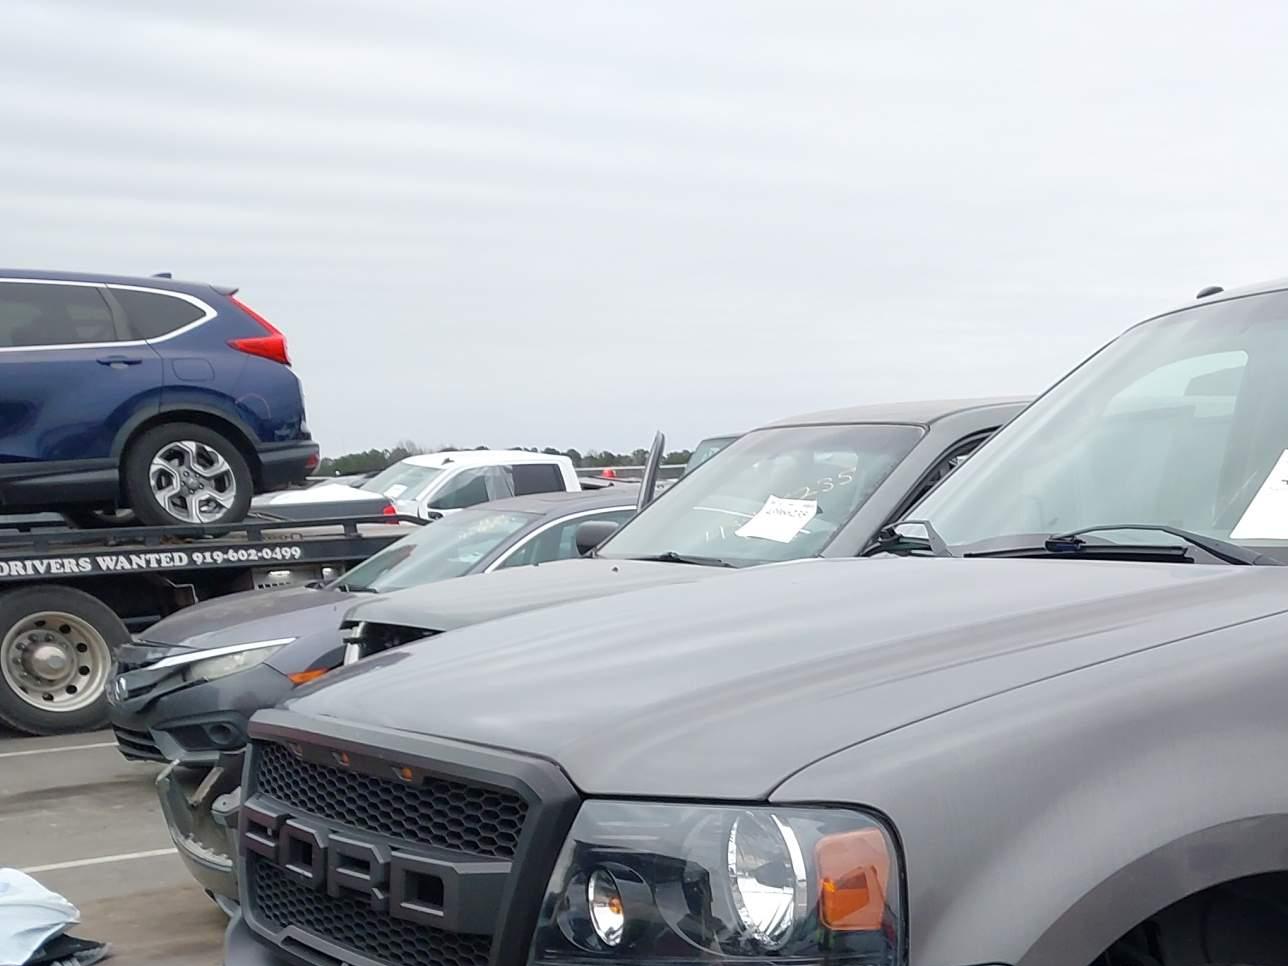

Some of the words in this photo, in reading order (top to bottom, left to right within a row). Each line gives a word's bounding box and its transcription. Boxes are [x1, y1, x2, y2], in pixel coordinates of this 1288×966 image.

[0, 557, 92, 576] DRIVERS
[96, 551, 188, 571] WANTED
[192, 546, 301, 565] 919-602-0499
[240, 800, 458, 932] FORD
